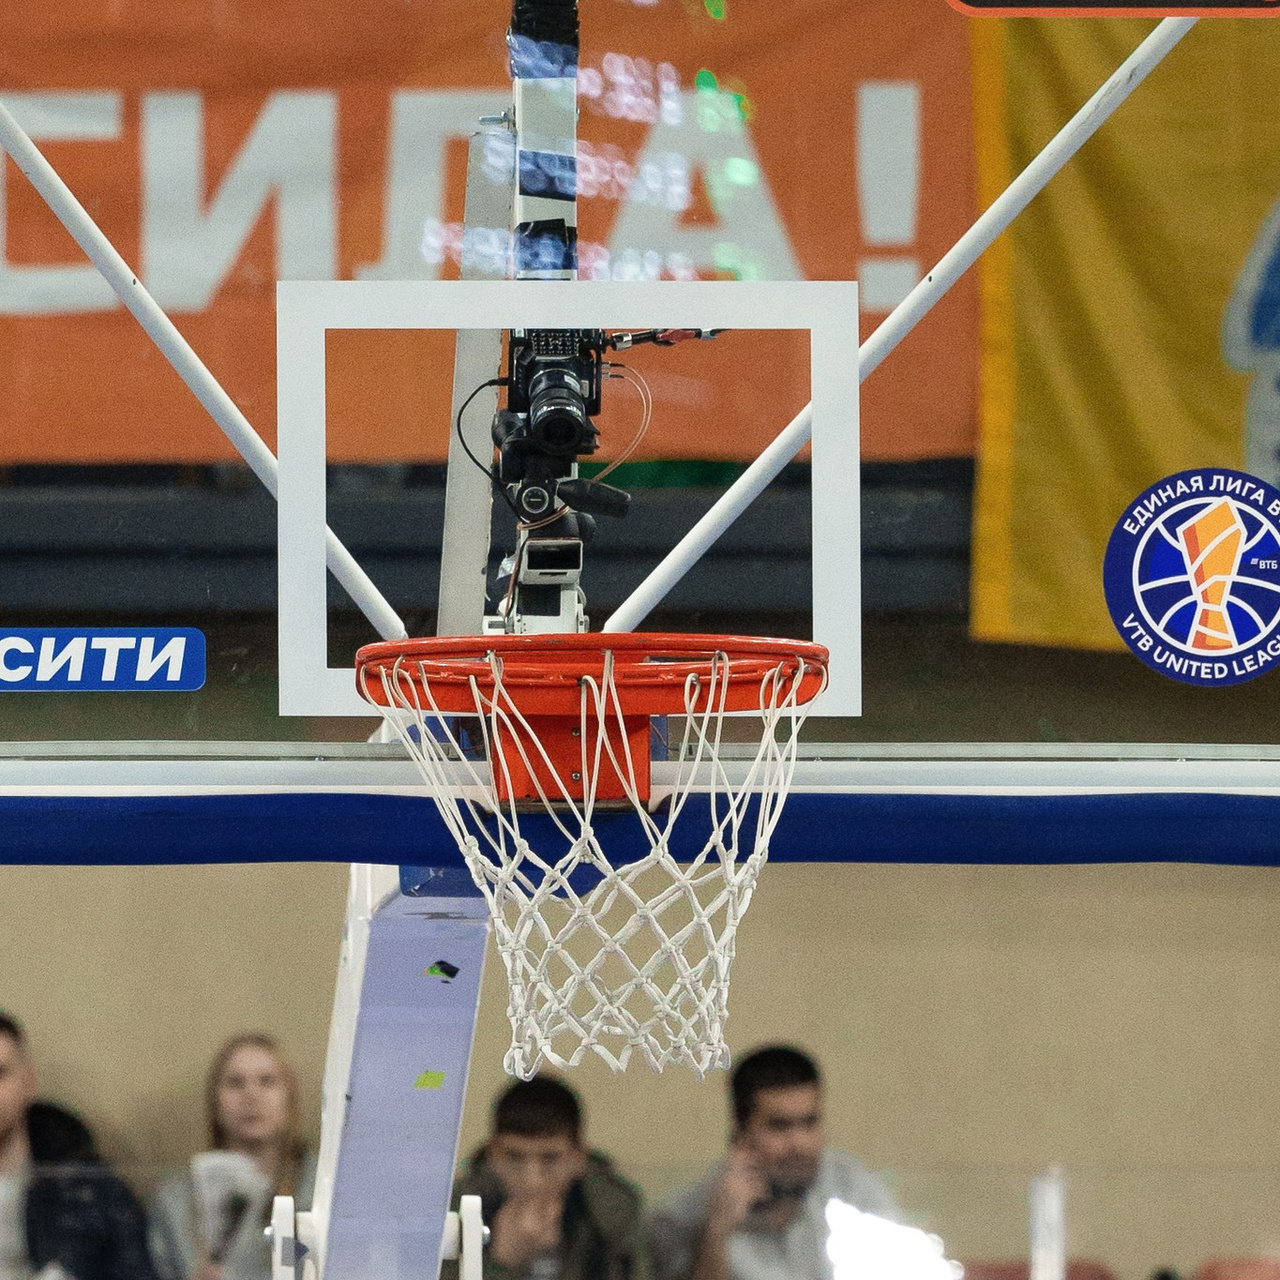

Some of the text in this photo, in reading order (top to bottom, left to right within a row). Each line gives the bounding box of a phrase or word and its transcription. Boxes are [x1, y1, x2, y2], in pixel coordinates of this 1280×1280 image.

[1122, 475, 1204, 535] ЕДИНАЯ
[1209, 475, 1265, 505] ЛИГА
[1259, 560, 1278, 570] ВТБ
[1122, 612, 1154, 652] VTB
[1152, 646, 1228, 679] UNITED
